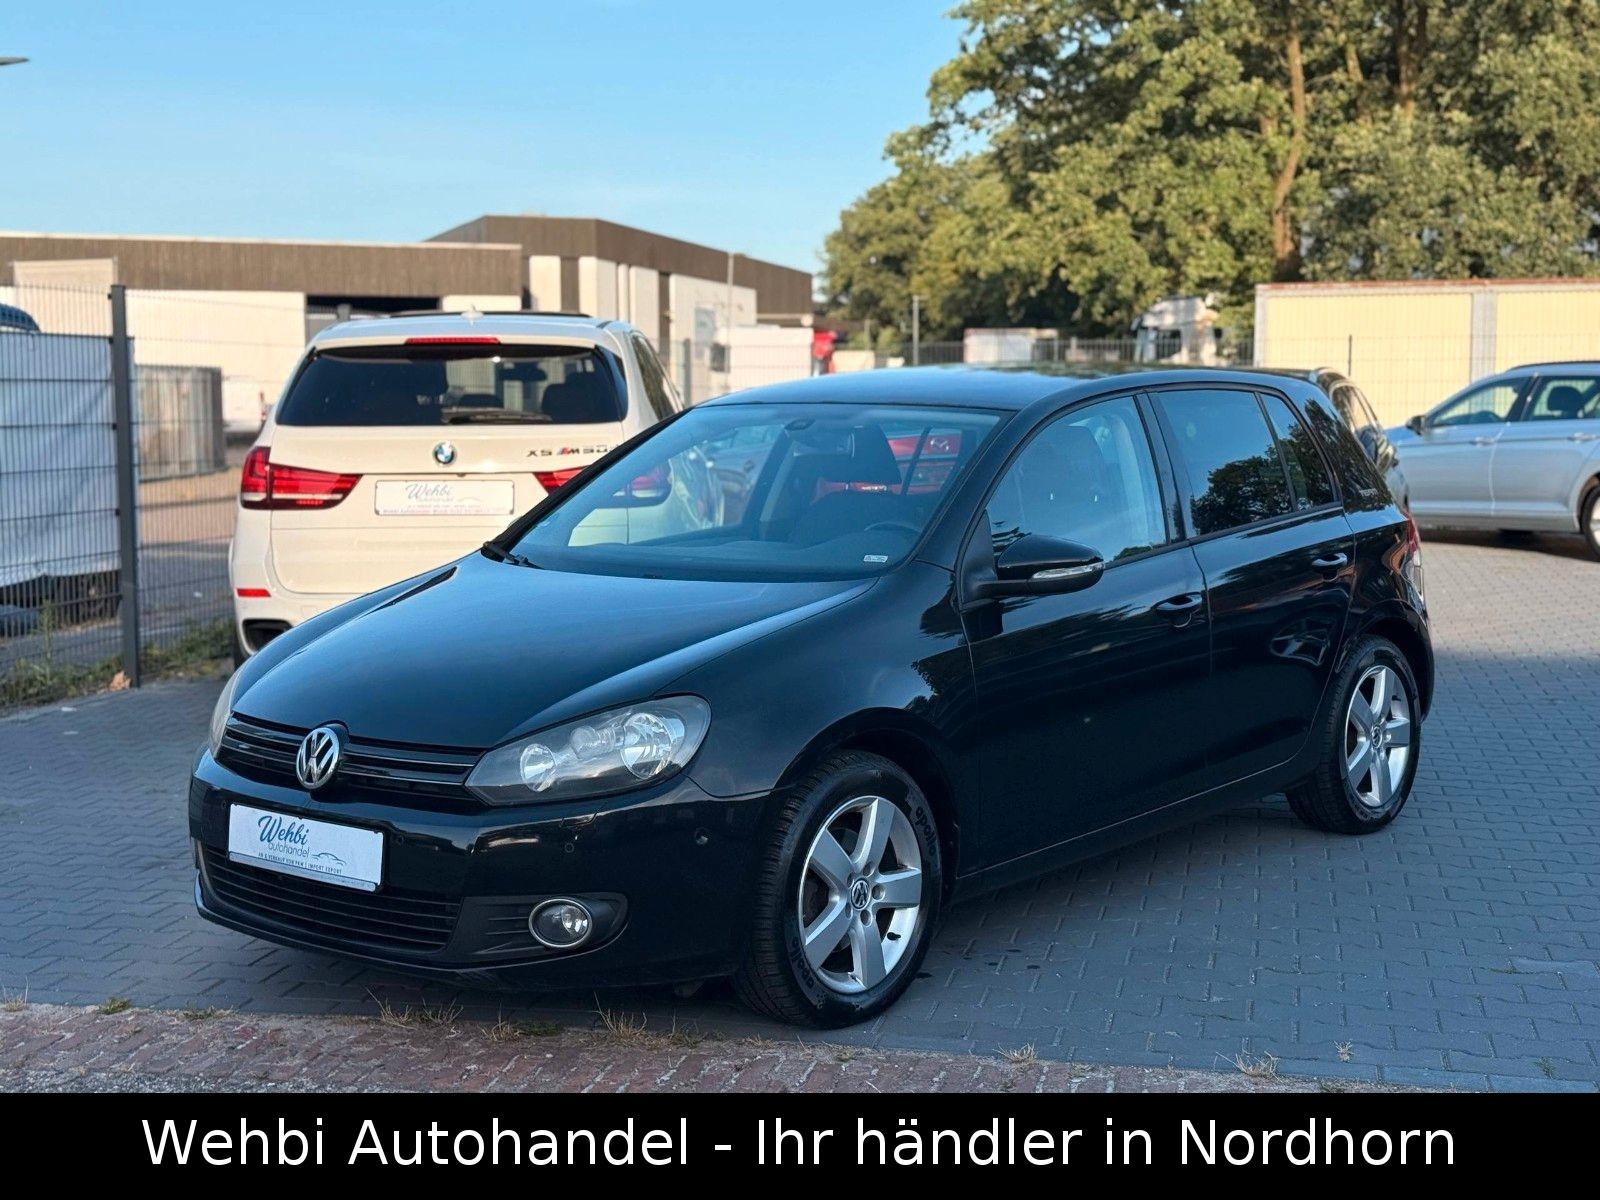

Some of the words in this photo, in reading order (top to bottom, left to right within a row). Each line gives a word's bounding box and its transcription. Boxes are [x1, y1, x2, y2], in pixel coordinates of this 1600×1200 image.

[527, 449, 553, 457] X5
[405, 483, 453, 499] Wehbi
[258, 815, 309, 845] Wehbi
[268, 842, 310, 857] autohandel
